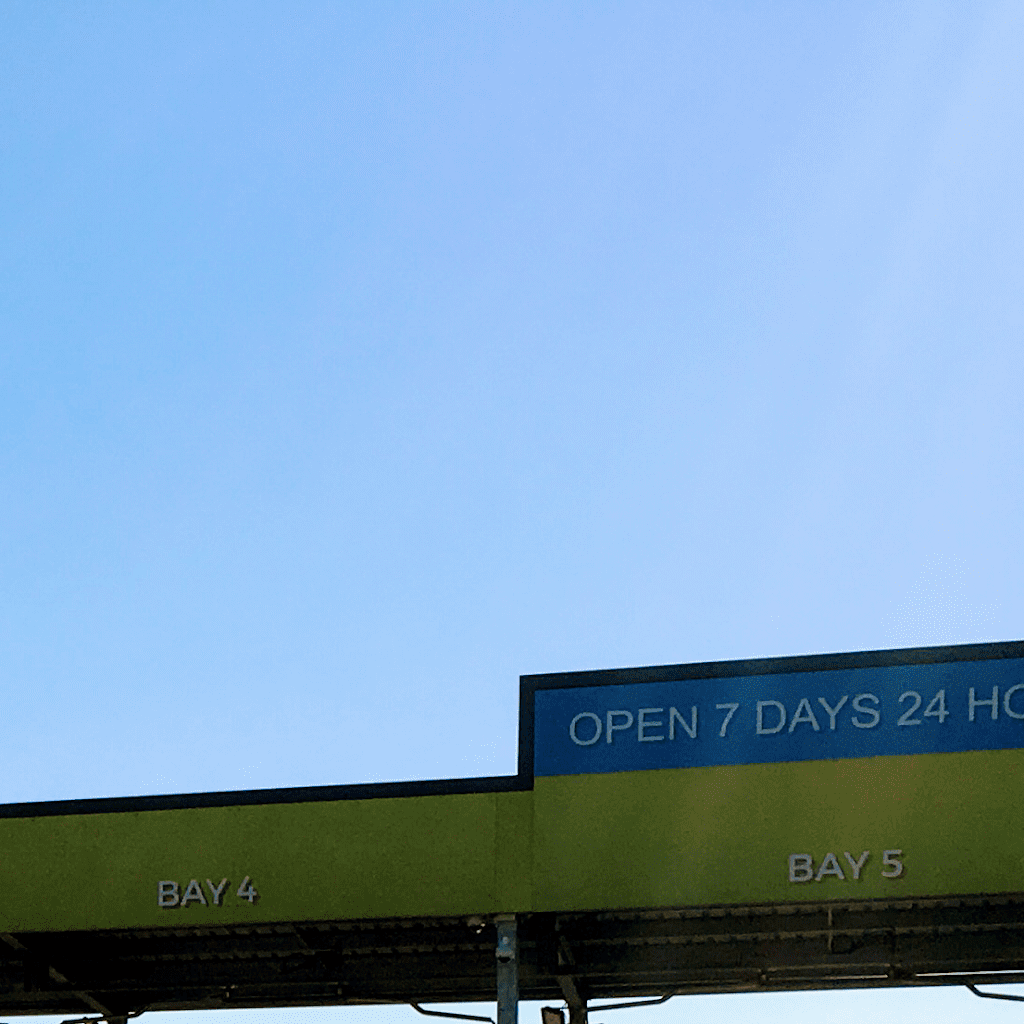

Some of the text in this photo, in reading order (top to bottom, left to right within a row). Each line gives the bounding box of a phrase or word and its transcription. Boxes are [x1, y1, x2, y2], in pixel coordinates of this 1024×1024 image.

[569, 706, 697, 745] OPEN
[716, 703, 739, 737] 7
[756, 693, 880, 735] DAYS
[897, 690, 949, 726] 24
[789, 849, 903, 882] BAY 5
[157, 875, 257, 906] BAY 4
